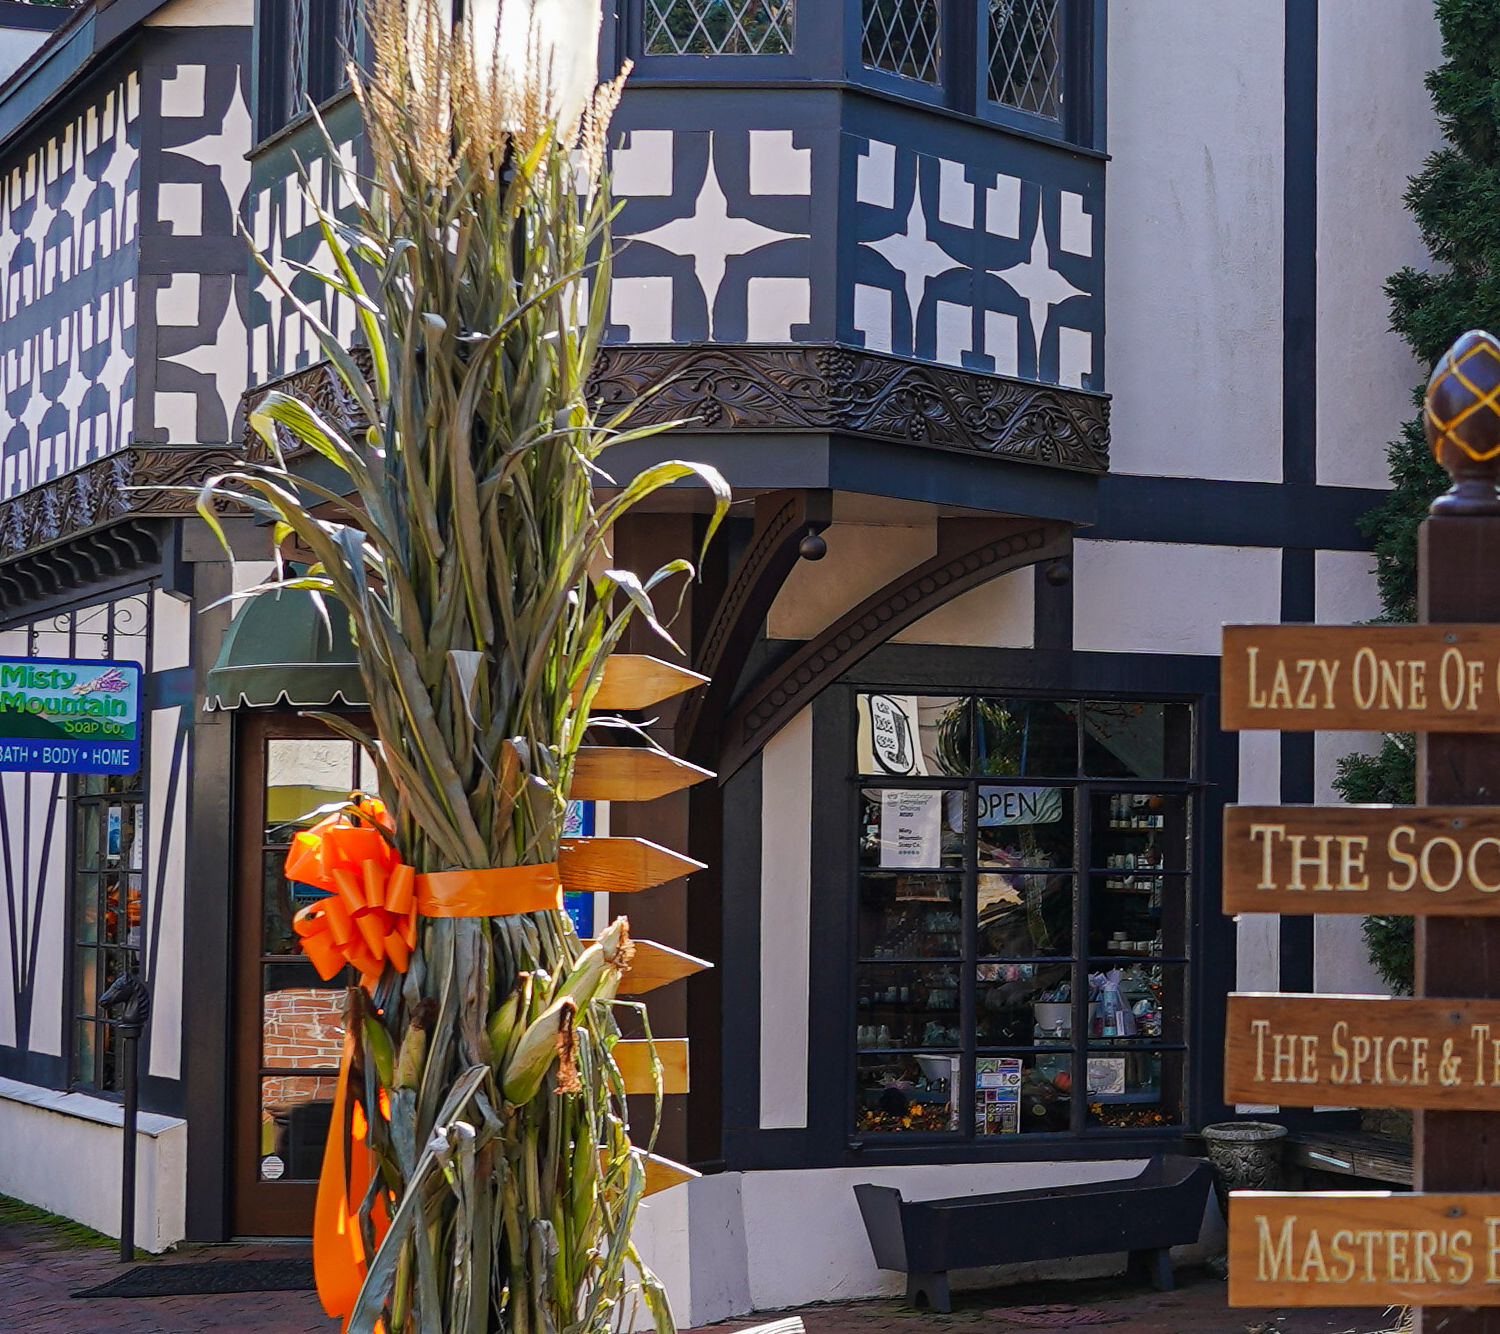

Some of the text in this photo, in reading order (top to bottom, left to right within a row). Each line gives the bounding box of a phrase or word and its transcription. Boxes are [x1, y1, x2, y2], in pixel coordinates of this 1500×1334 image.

[0, 665, 77, 690] Misty
[1246, 646, 1339, 710] LAZY
[1352, 647, 1427, 710] ONE
[0, 691, 127, 717] Mountain
[64, 719, 126, 735] Soap Co.
[42, 747, 80, 764] BODY
[92, 749, 130, 766] HOME
[1439, 1037, 1462, 1087] &
